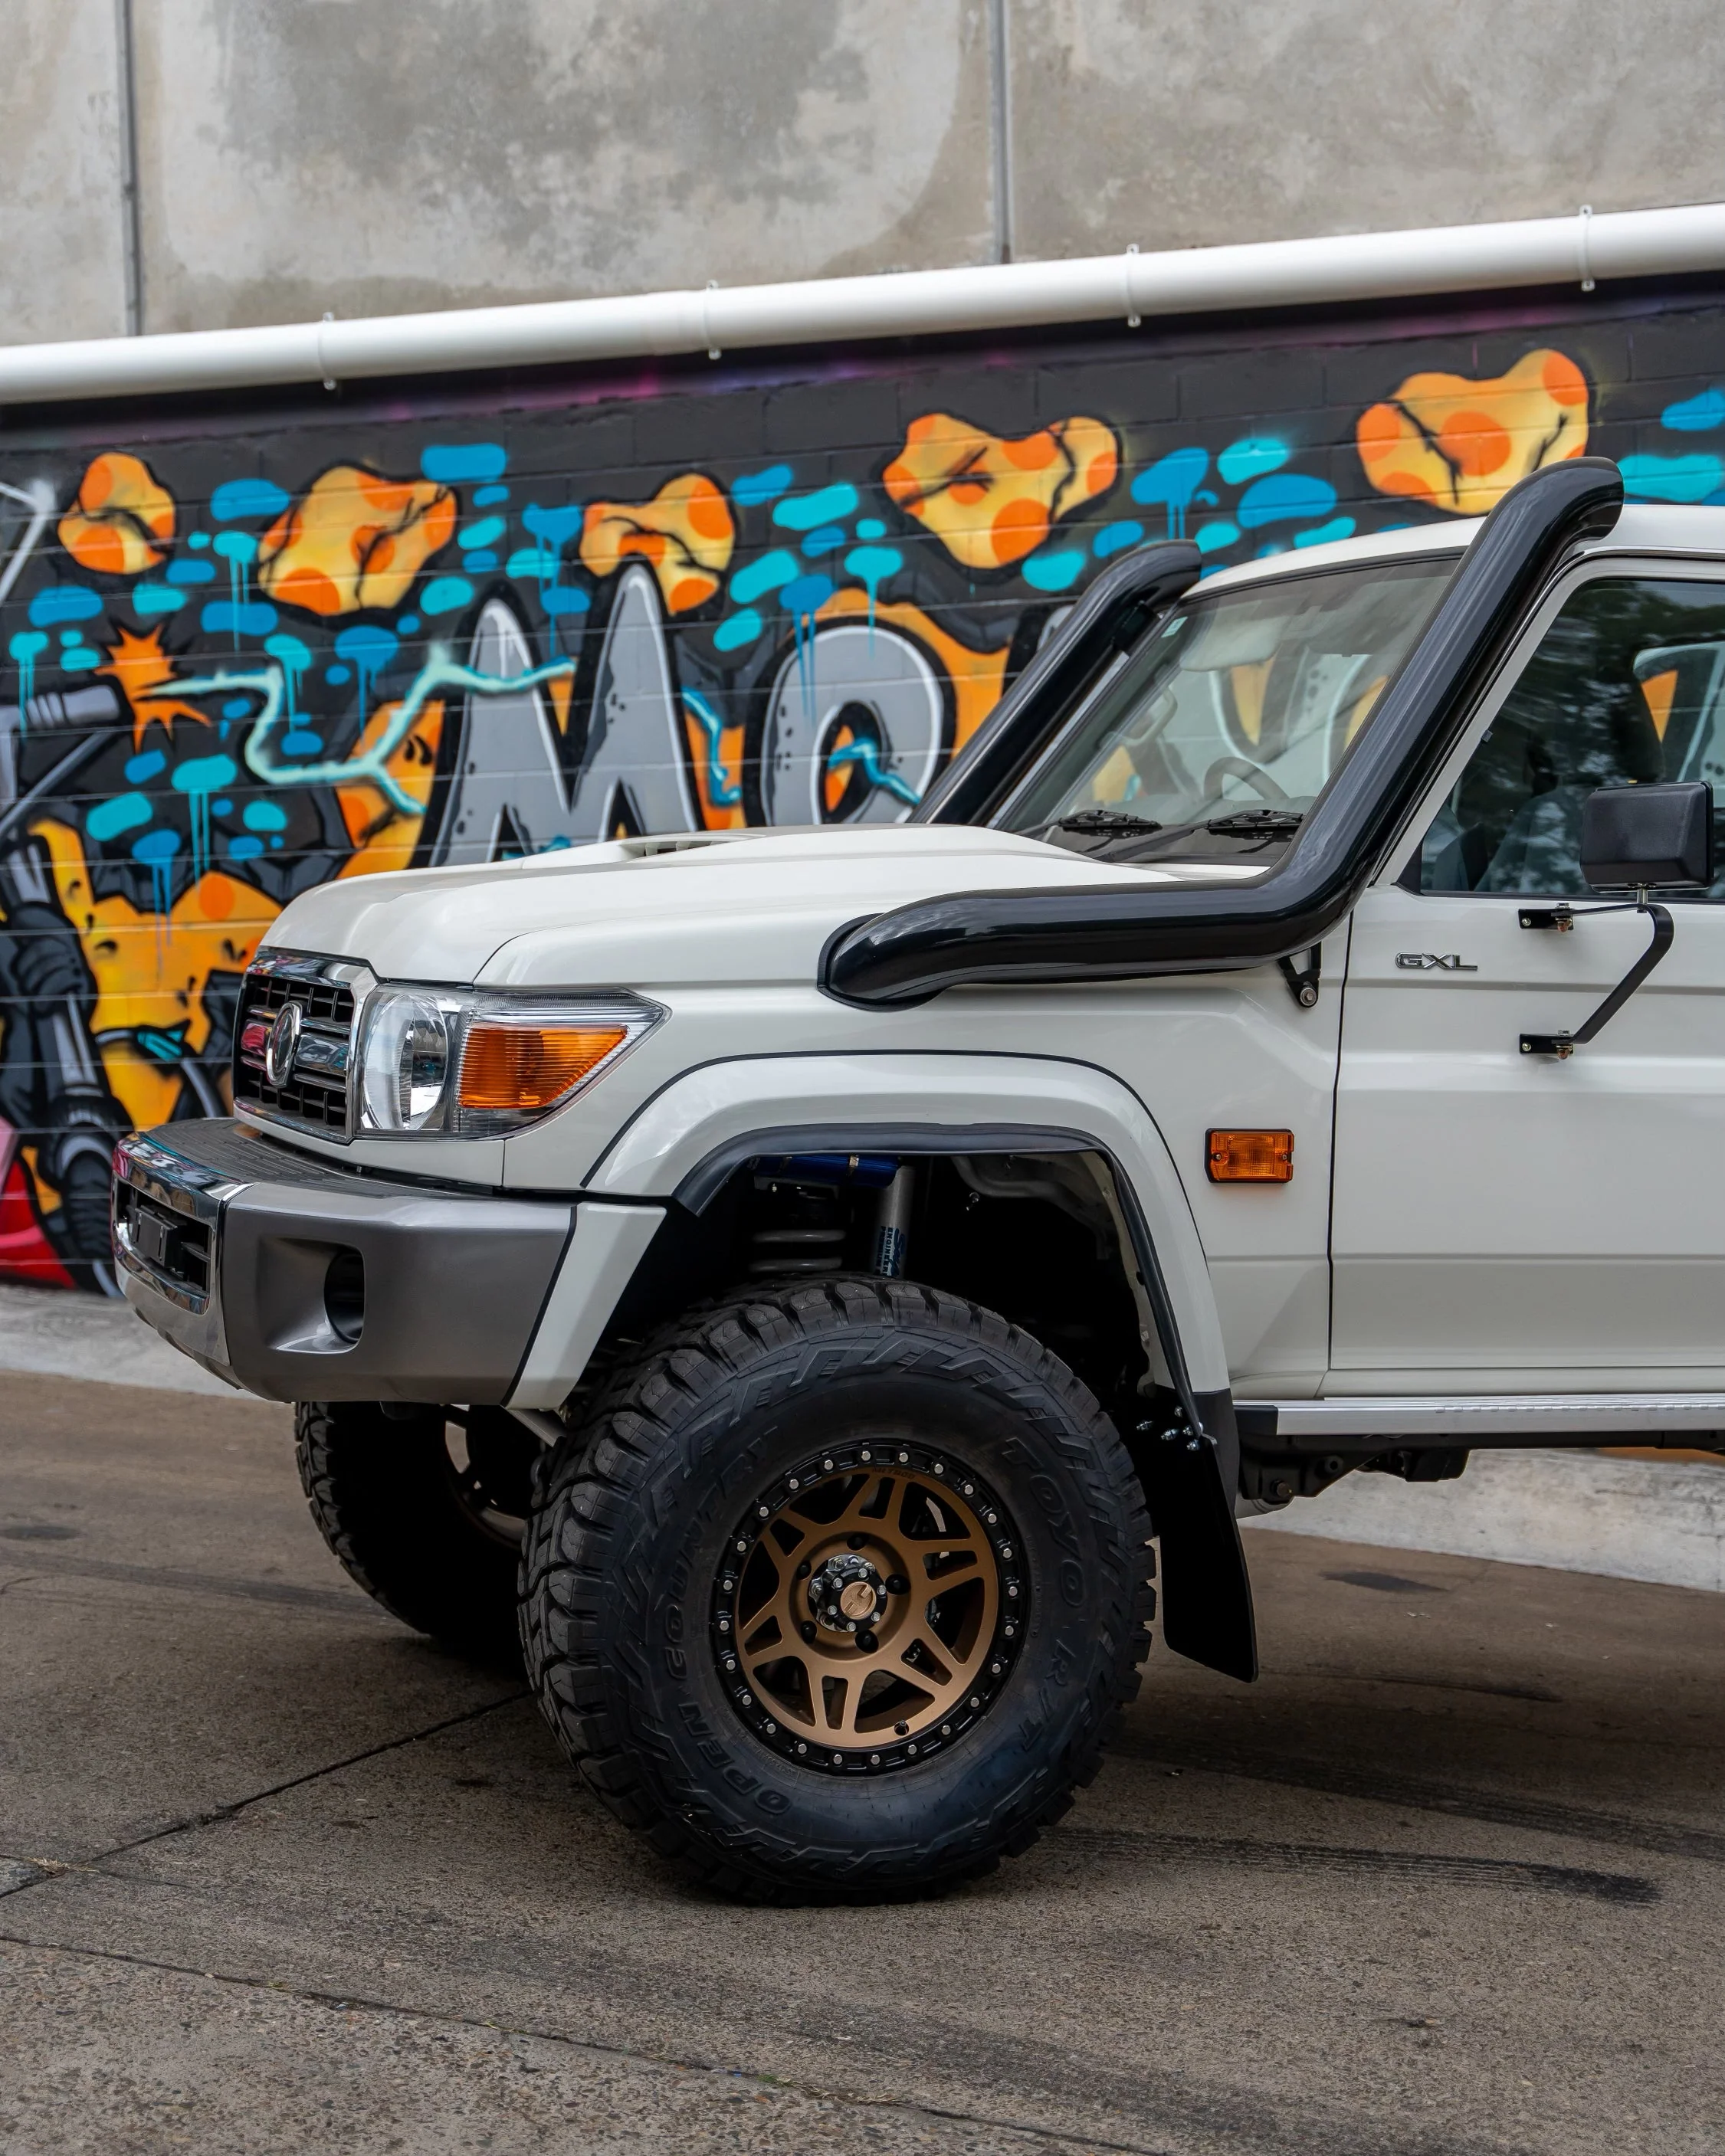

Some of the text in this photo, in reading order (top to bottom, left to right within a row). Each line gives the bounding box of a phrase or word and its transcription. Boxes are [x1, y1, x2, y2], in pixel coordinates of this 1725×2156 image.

[1395, 952, 1478, 972] GXL
[664, 1424, 779, 1681] COUNTRY
[1001, 1437, 1088, 1608] TOYO
[677, 1699, 792, 1815] OPEN
